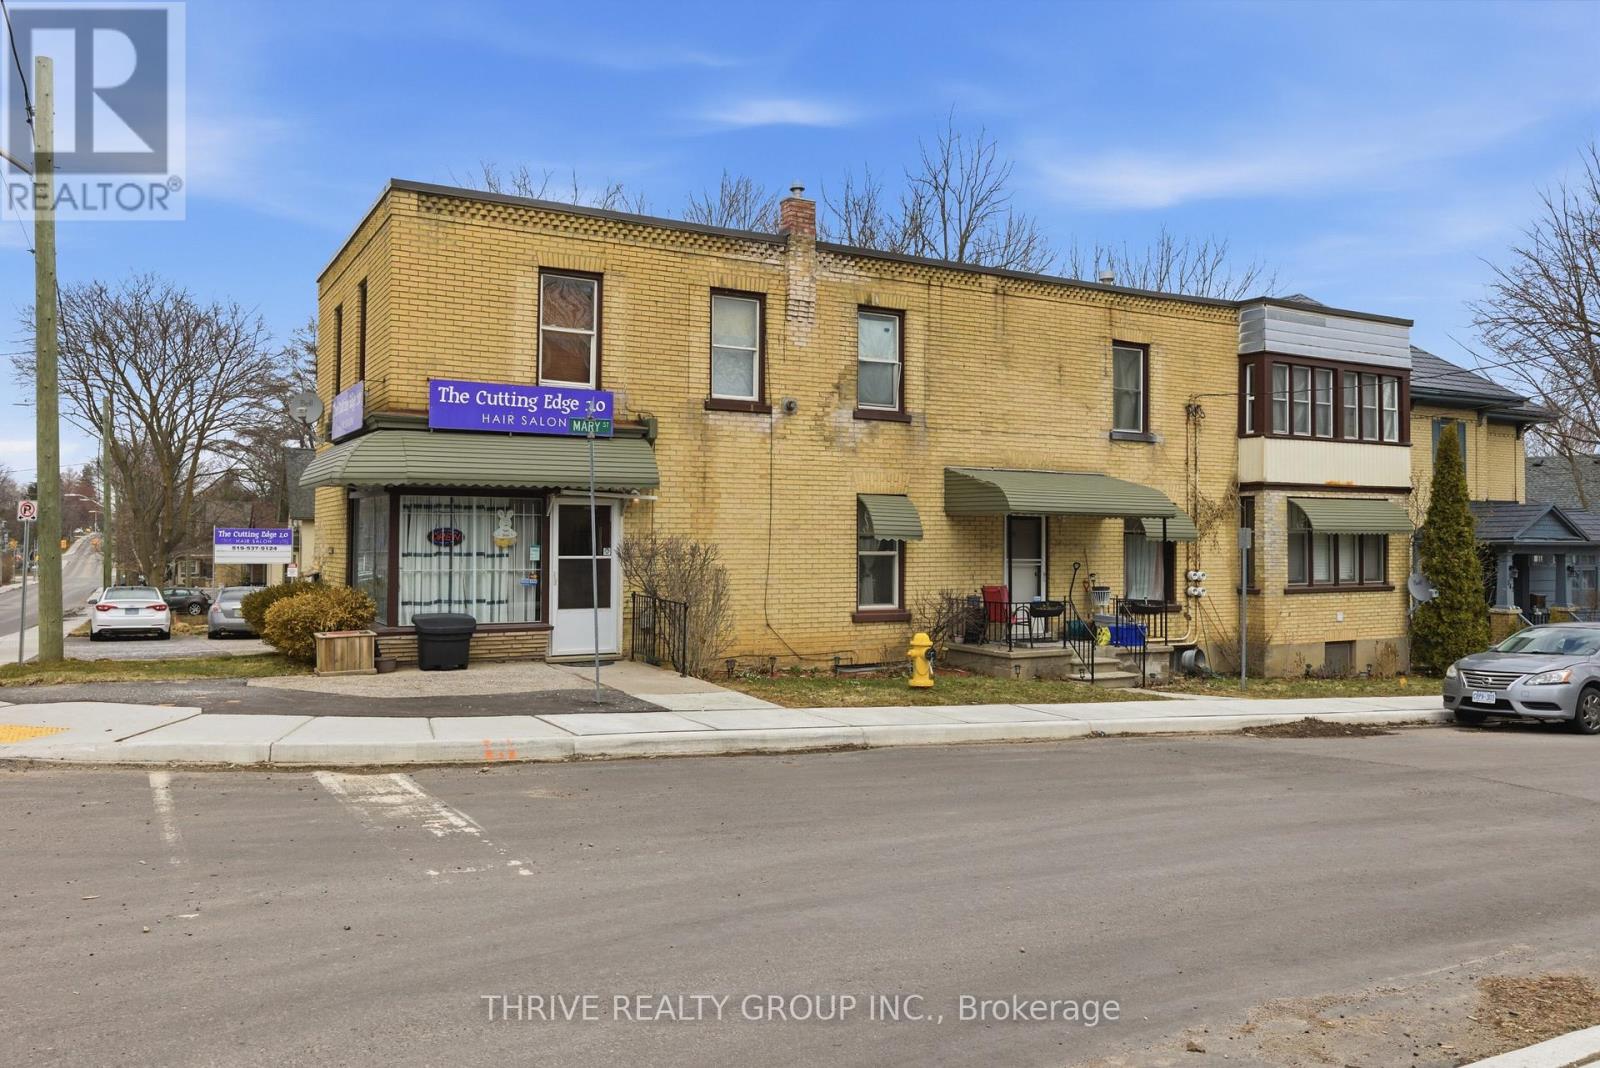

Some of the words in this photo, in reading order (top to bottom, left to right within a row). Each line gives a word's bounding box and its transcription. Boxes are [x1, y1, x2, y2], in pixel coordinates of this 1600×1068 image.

[438, 386, 470, 404] The
[476, 390, 538, 412] Cutting
[544, 394, 580, 414] Edge
[482, 413, 515, 425] HAIR
[521, 415, 567, 428] SALON
[573, 420, 601, 432] MARY
[233, 531, 260, 539] Cutting
[261, 531, 277, 539] Edge
